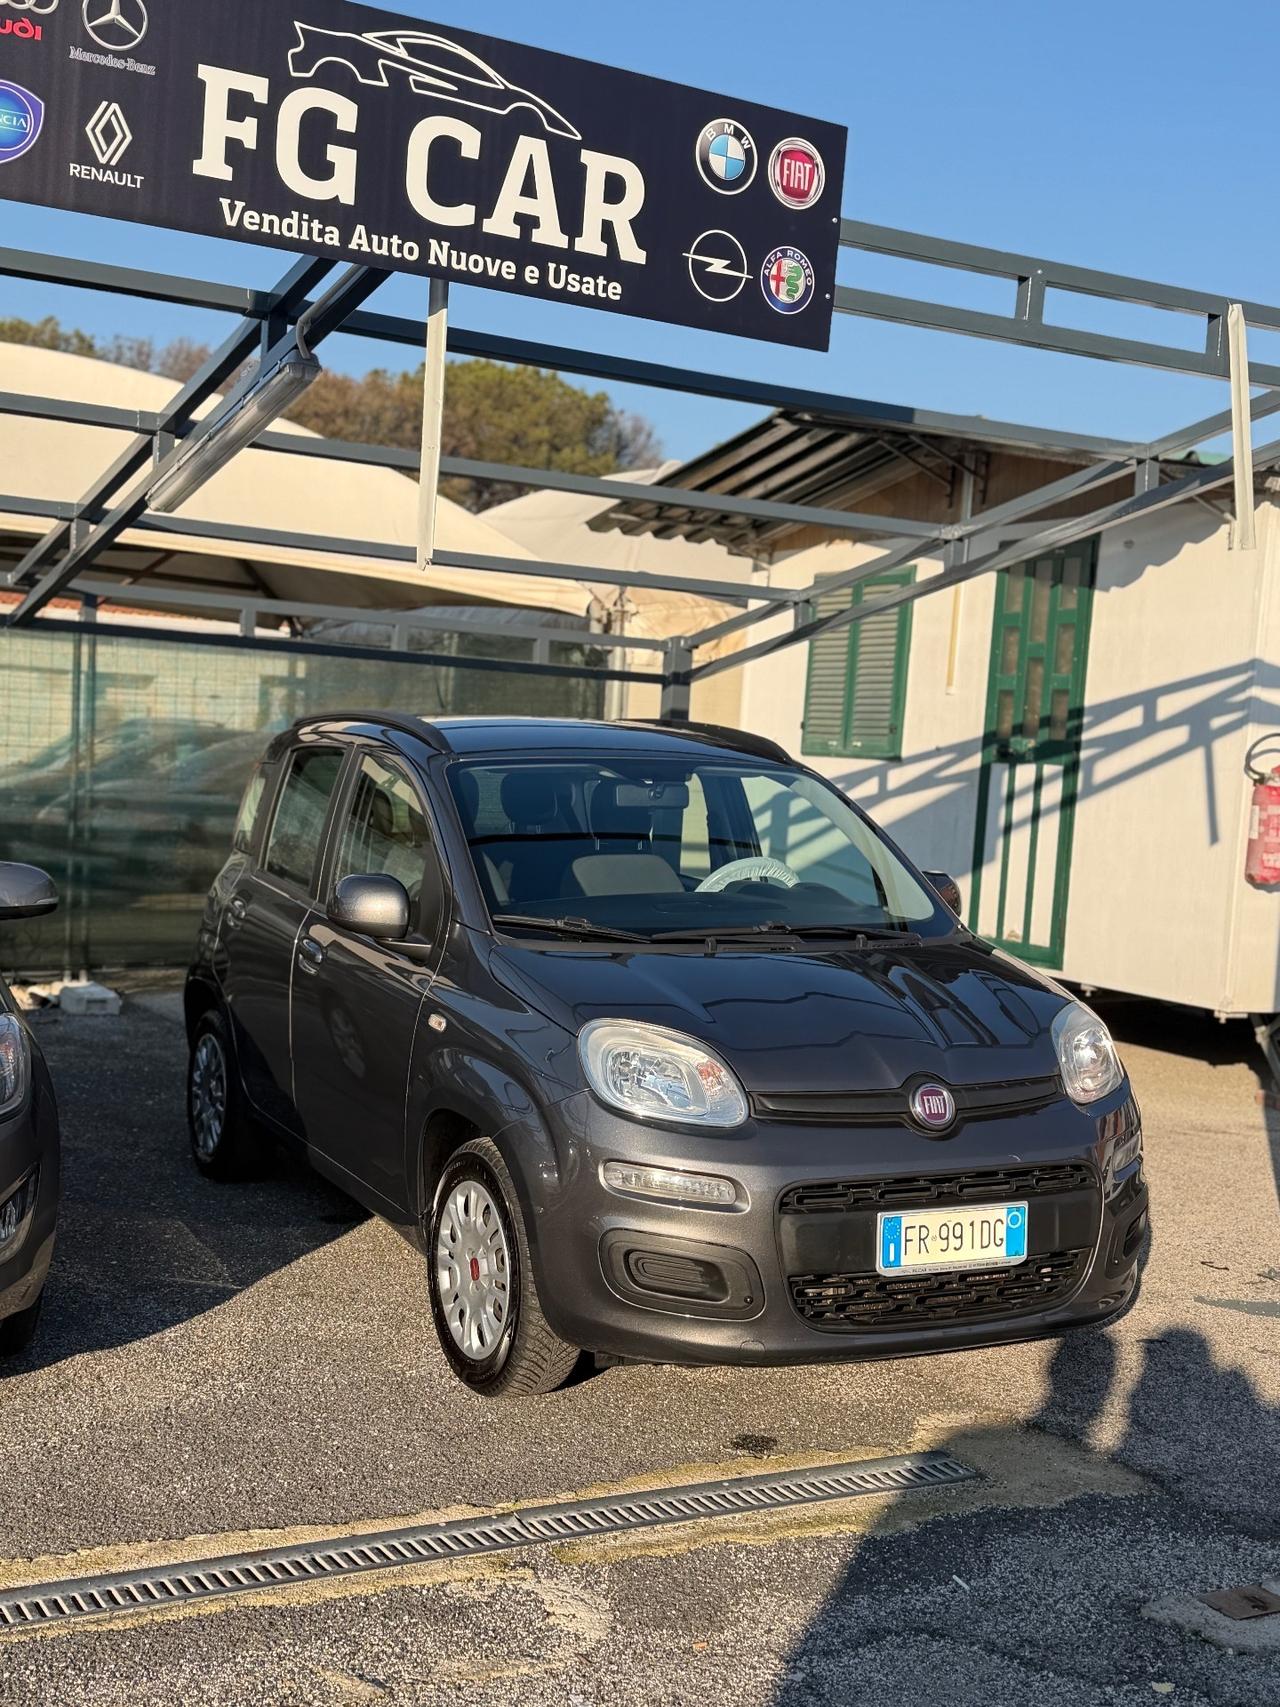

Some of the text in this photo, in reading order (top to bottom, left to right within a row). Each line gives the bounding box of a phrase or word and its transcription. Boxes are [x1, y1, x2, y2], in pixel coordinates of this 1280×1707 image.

[0, 16, 42, 41] udi
[69, 45, 156, 76] Mercedes-Benz
[705, 123, 752, 150] BMW
[69, 162, 145, 189] RENAULT
[192, 63, 647, 265] FG CAR
[782, 158, 813, 191] FIAT
[218, 196, 622, 301] Vendita Auto Nuove e Usate
[763, 249, 813, 287] ALFA ROMEO
[922, 1095, 946, 1115] FIAT
